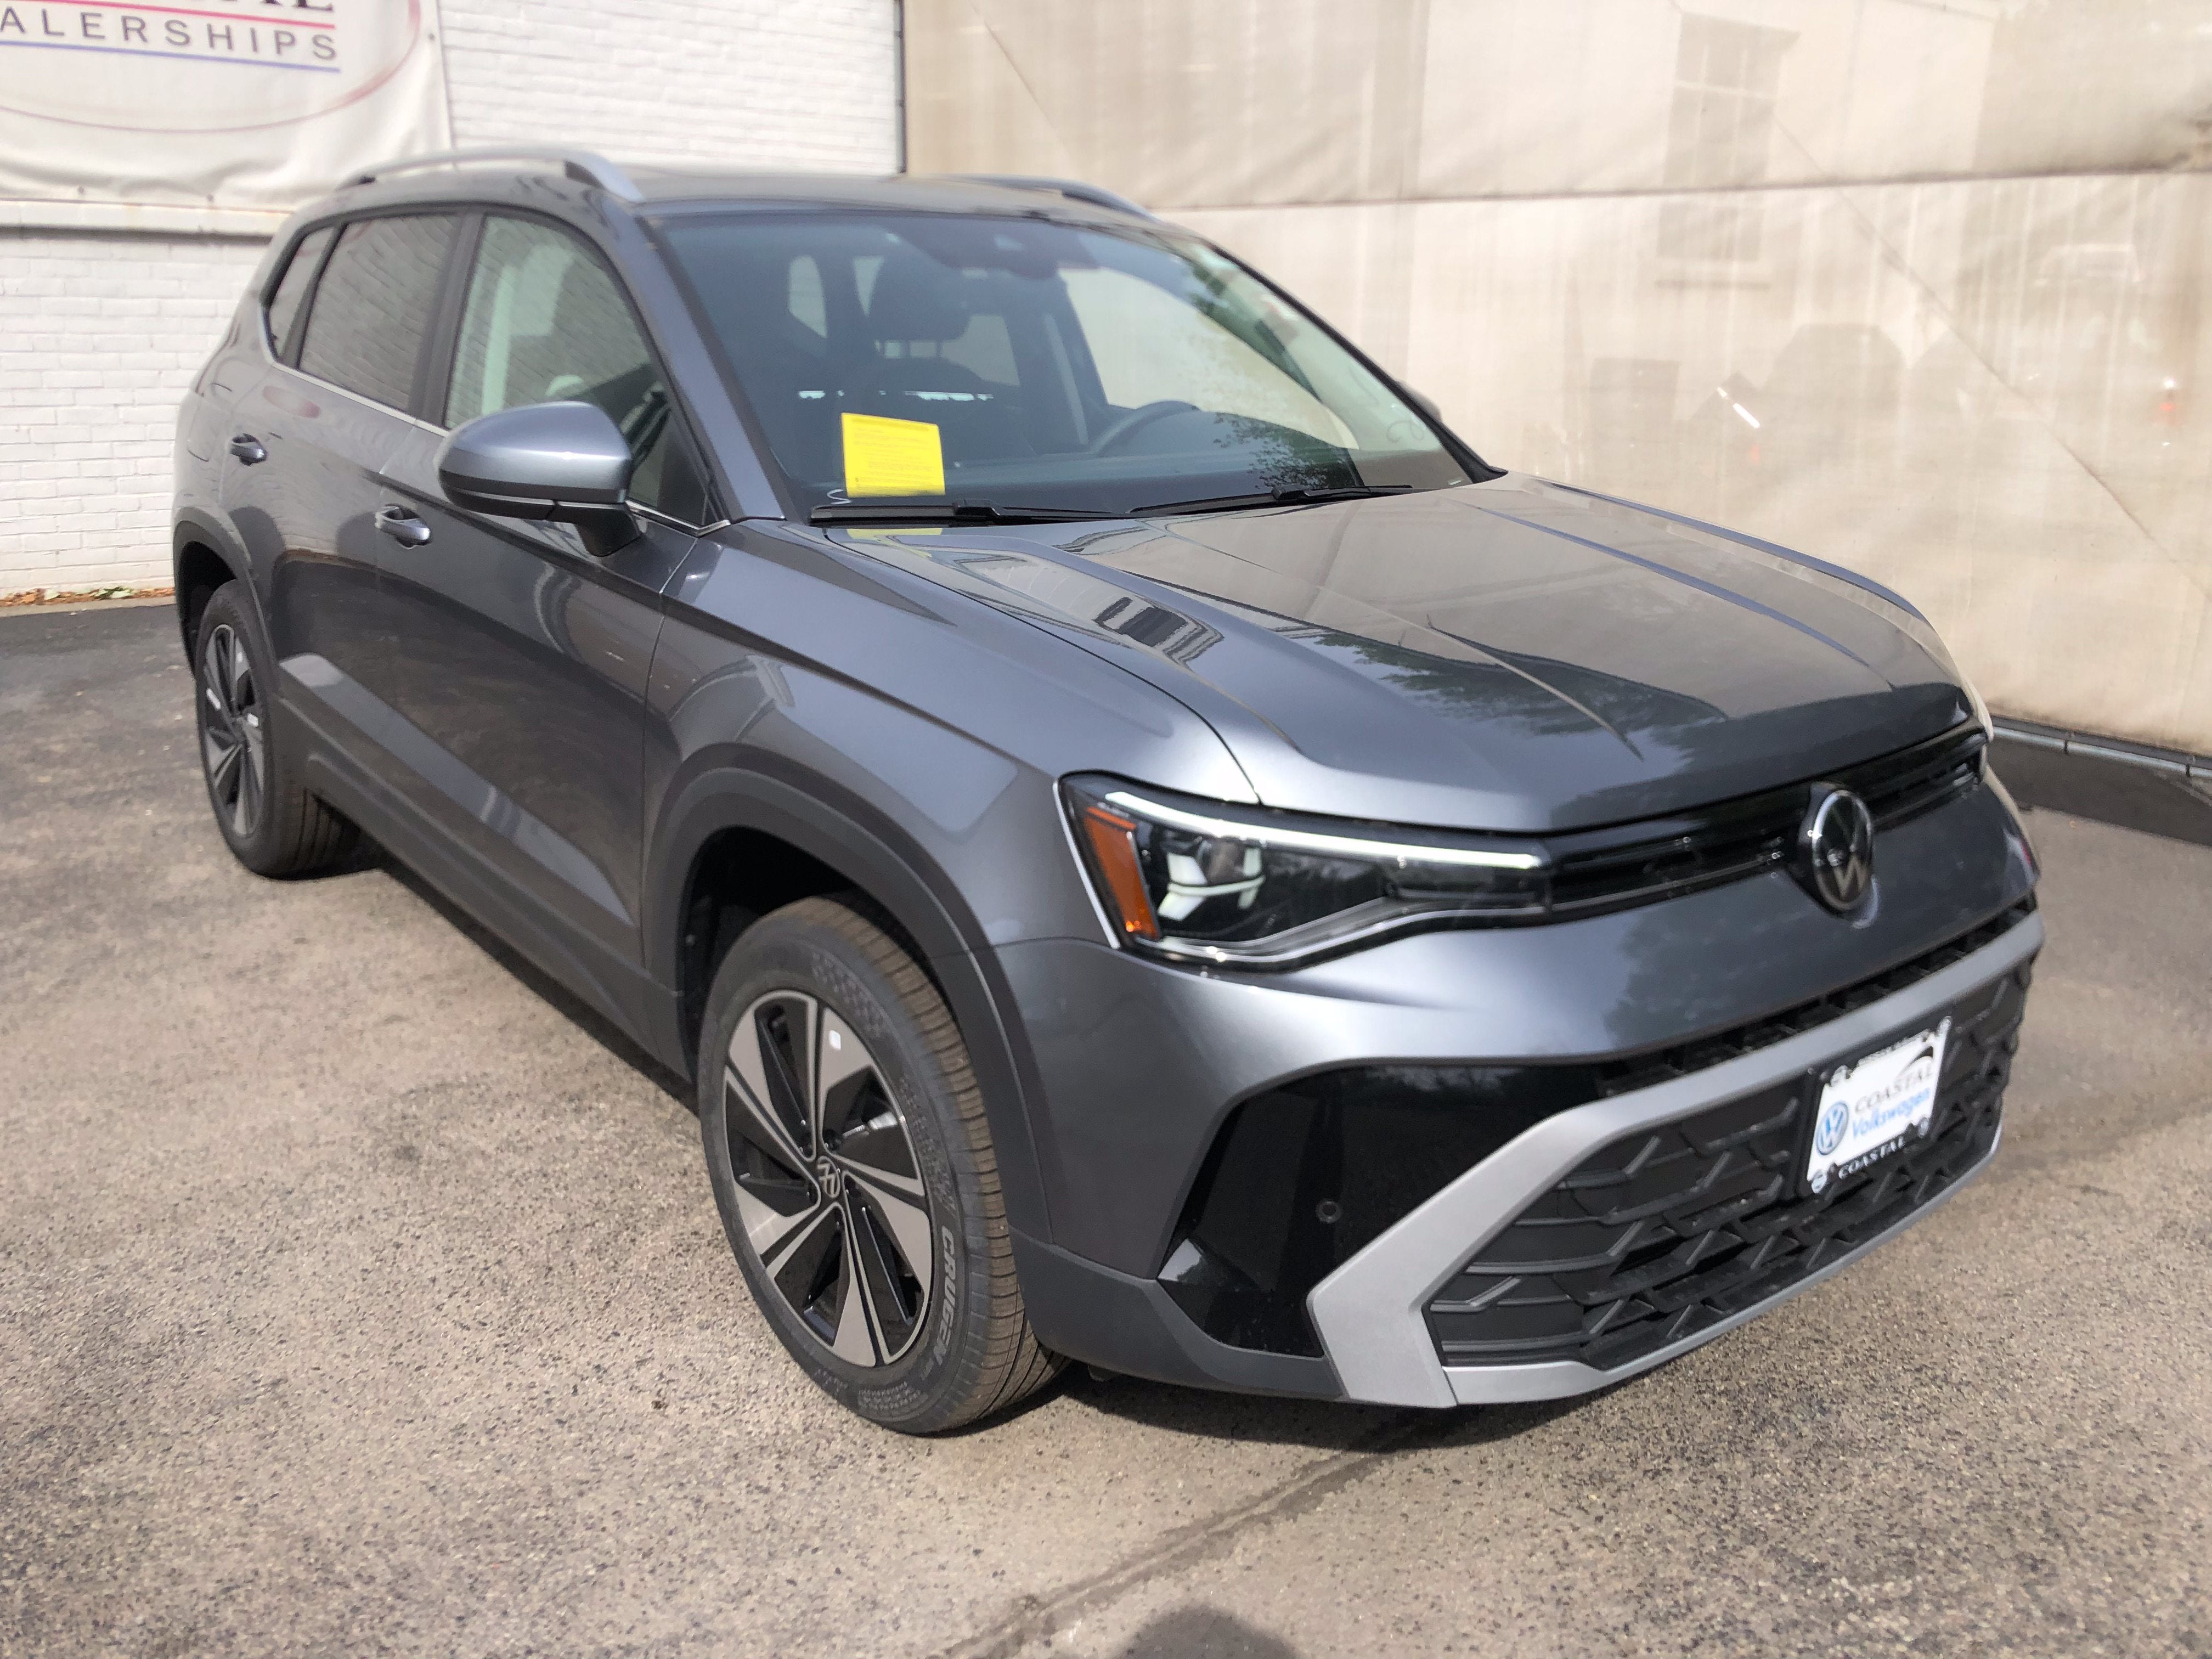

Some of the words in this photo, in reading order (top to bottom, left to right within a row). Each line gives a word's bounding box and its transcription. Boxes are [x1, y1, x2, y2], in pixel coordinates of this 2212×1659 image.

[1854, 1063, 1933, 1114] COASTAL
[1838, 1135, 1905, 1179] COASTAL
[933, 1224, 956, 1365] CRUGEN
